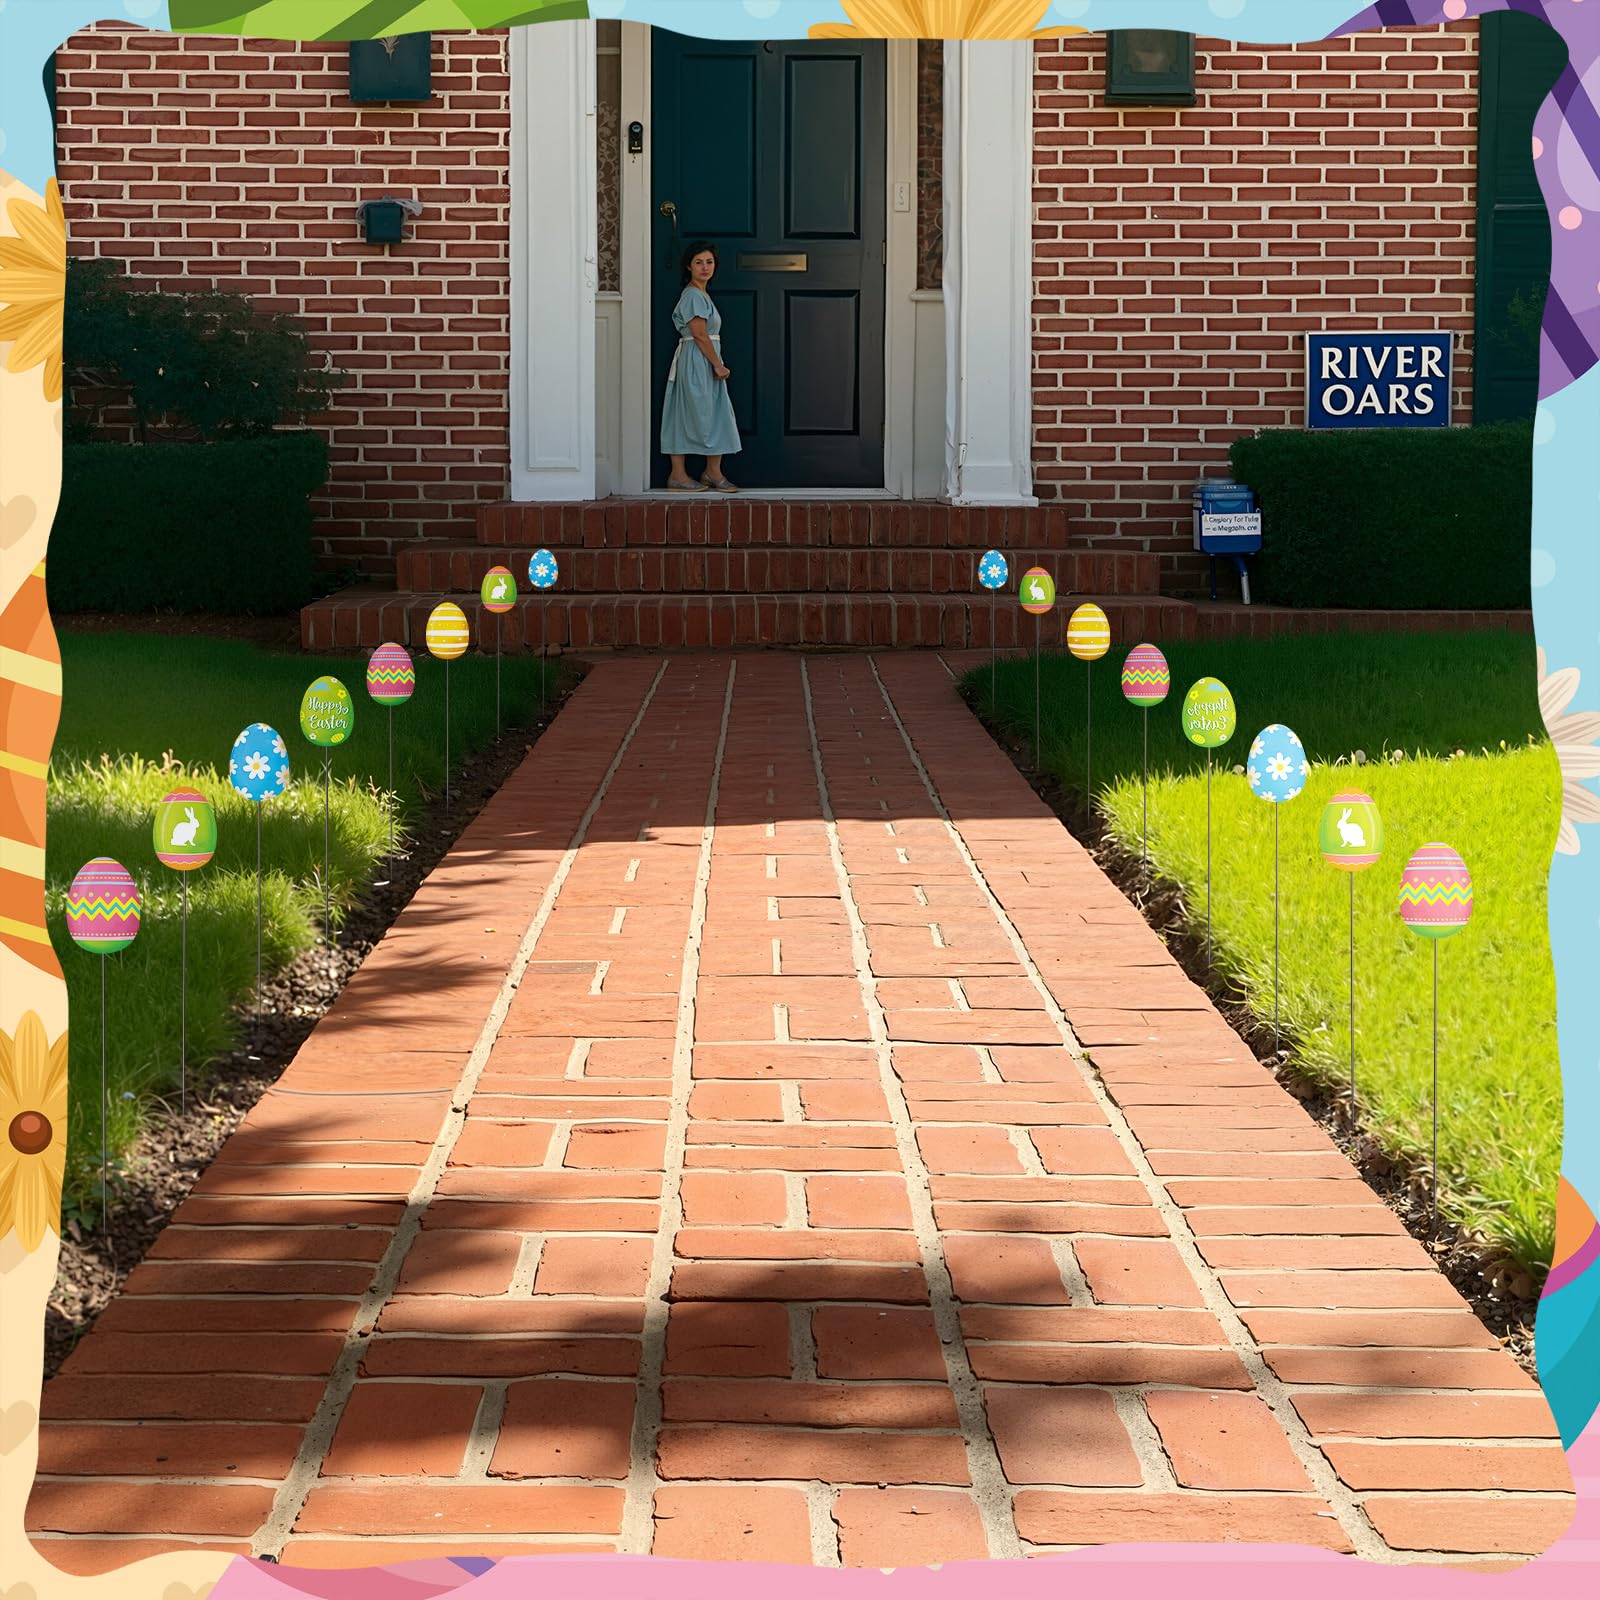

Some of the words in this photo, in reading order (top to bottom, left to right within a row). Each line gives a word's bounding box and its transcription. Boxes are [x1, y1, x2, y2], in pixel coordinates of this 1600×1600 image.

[1321, 346, 1446, 379] RIVER
[1322, 383, 1434, 416] OARS
[308, 696, 348, 715] Happy
[306, 714, 348, 730] Easter
